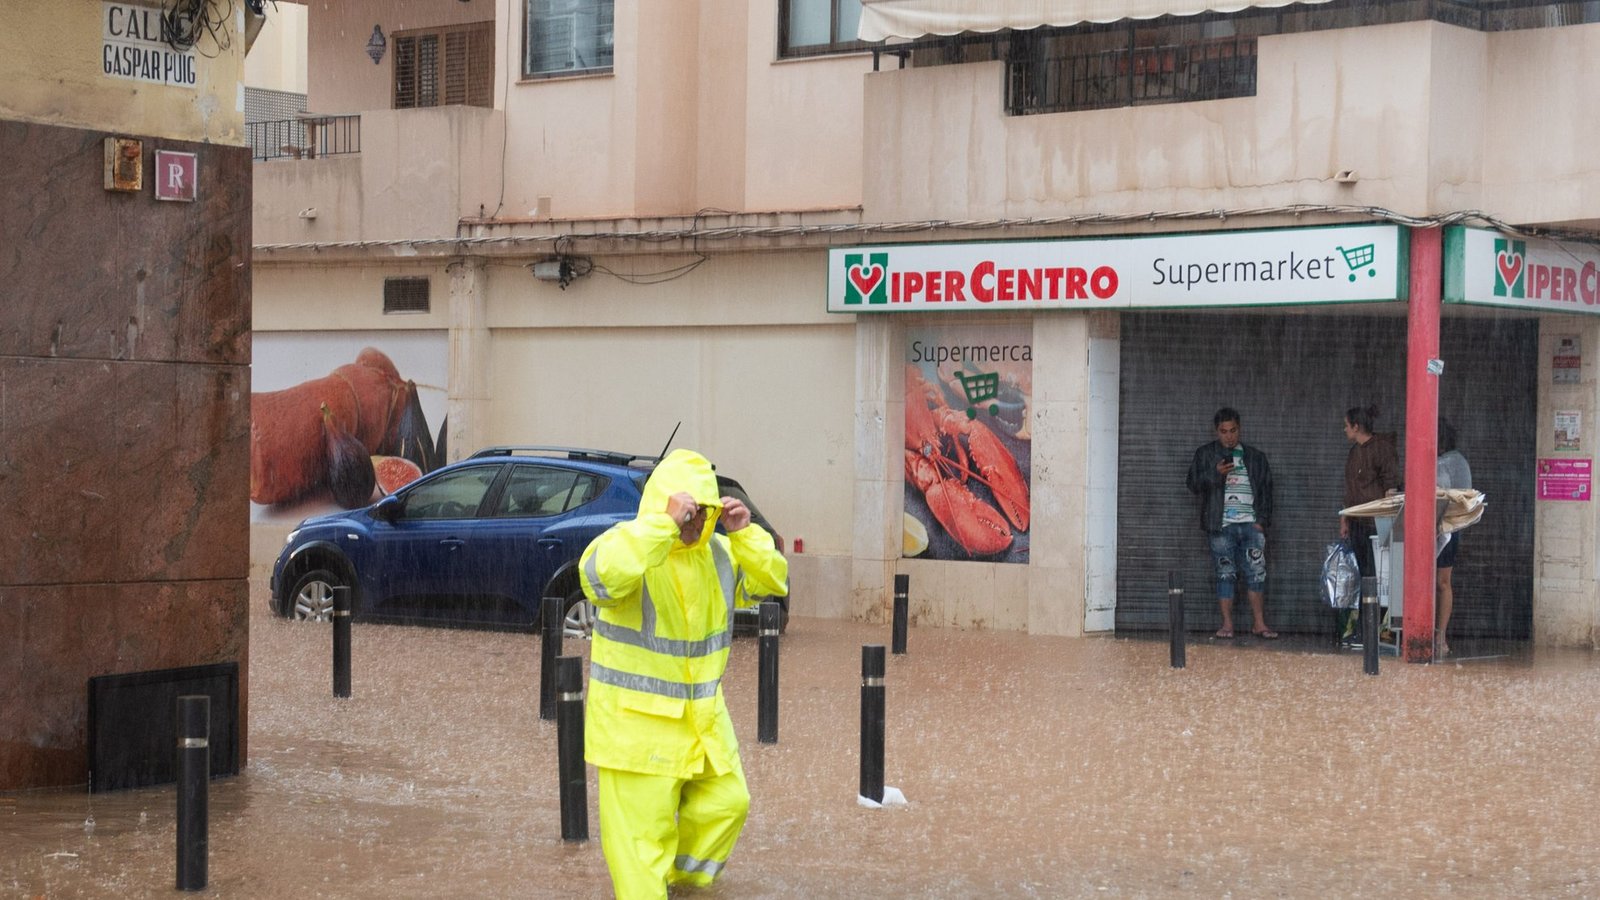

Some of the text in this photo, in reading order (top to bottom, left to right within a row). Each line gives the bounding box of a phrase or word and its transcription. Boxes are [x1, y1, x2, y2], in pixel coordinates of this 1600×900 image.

[108, 6, 188, 44] CALL
[104, 44, 196, 84] GASPAR PUIG
[167, 163, 185, 188] R
[1152, 251, 1335, 291] Supermarket
[912, 340, 1033, 367] Supermerca
